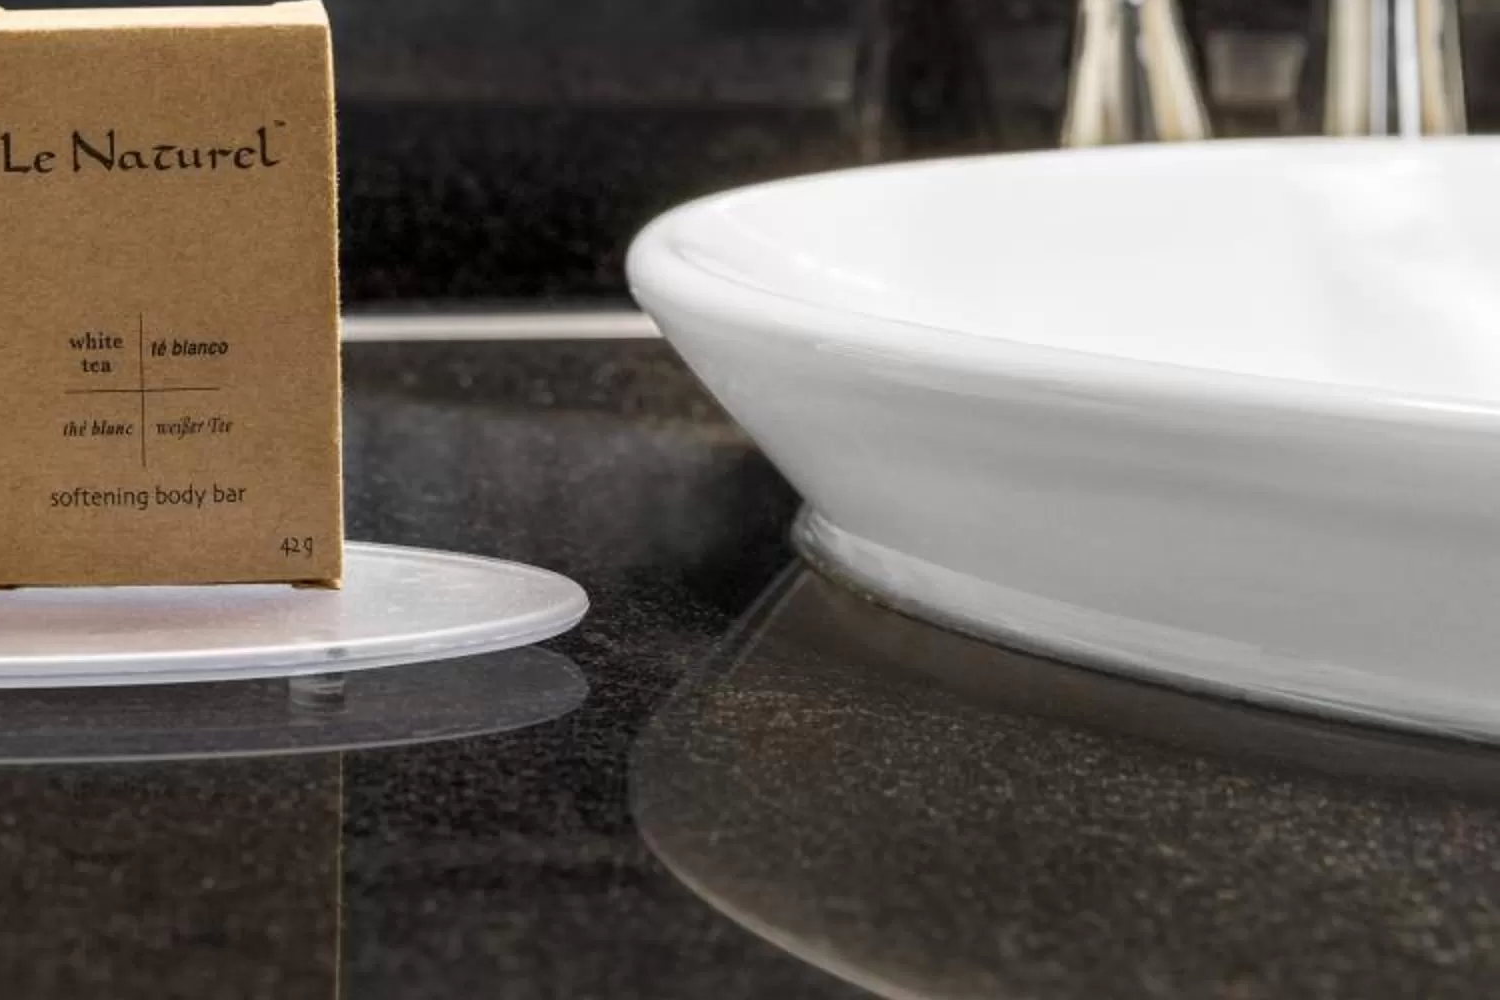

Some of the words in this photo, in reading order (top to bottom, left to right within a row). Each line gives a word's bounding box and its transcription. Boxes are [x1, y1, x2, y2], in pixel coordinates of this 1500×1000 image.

[0, 130, 57, 174] Le
[71, 125, 281, 174] Naturel
[68, 332, 124, 350] white
[171, 338, 229, 357] blanco
[81, 359, 112, 373] tea
[91, 420, 133, 437] blanc
[51, 486, 149, 511] softening
[155, 483, 207, 508] body
[212, 483, 248, 504] bar
